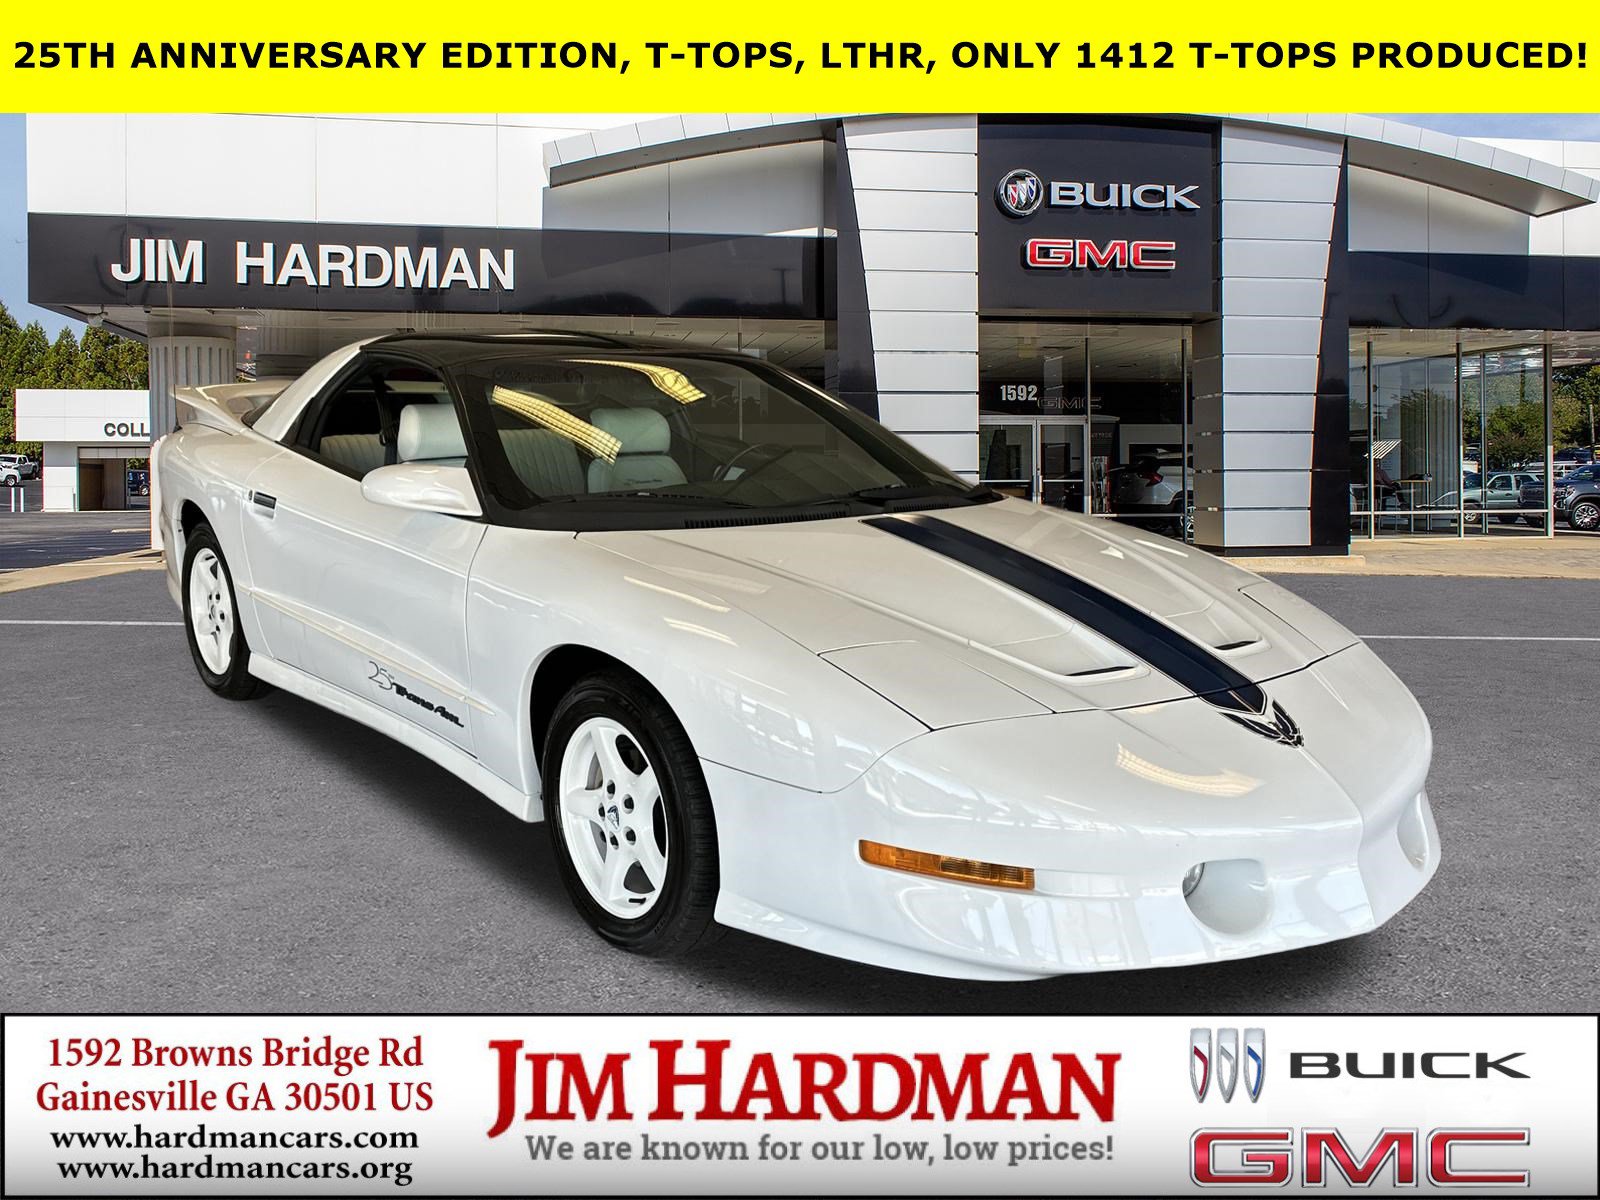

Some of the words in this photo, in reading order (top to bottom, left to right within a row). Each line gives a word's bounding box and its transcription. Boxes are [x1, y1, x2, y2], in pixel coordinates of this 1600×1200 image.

[1050, 181, 1200, 209] BUICK
[111, 238, 204, 284] JIM
[235, 241, 515, 290] HARDMAN
[1026, 238, 1176, 269] GMC
[1000, 385, 1038, 401] 1592
[1036, 396, 1102, 409] GMC
